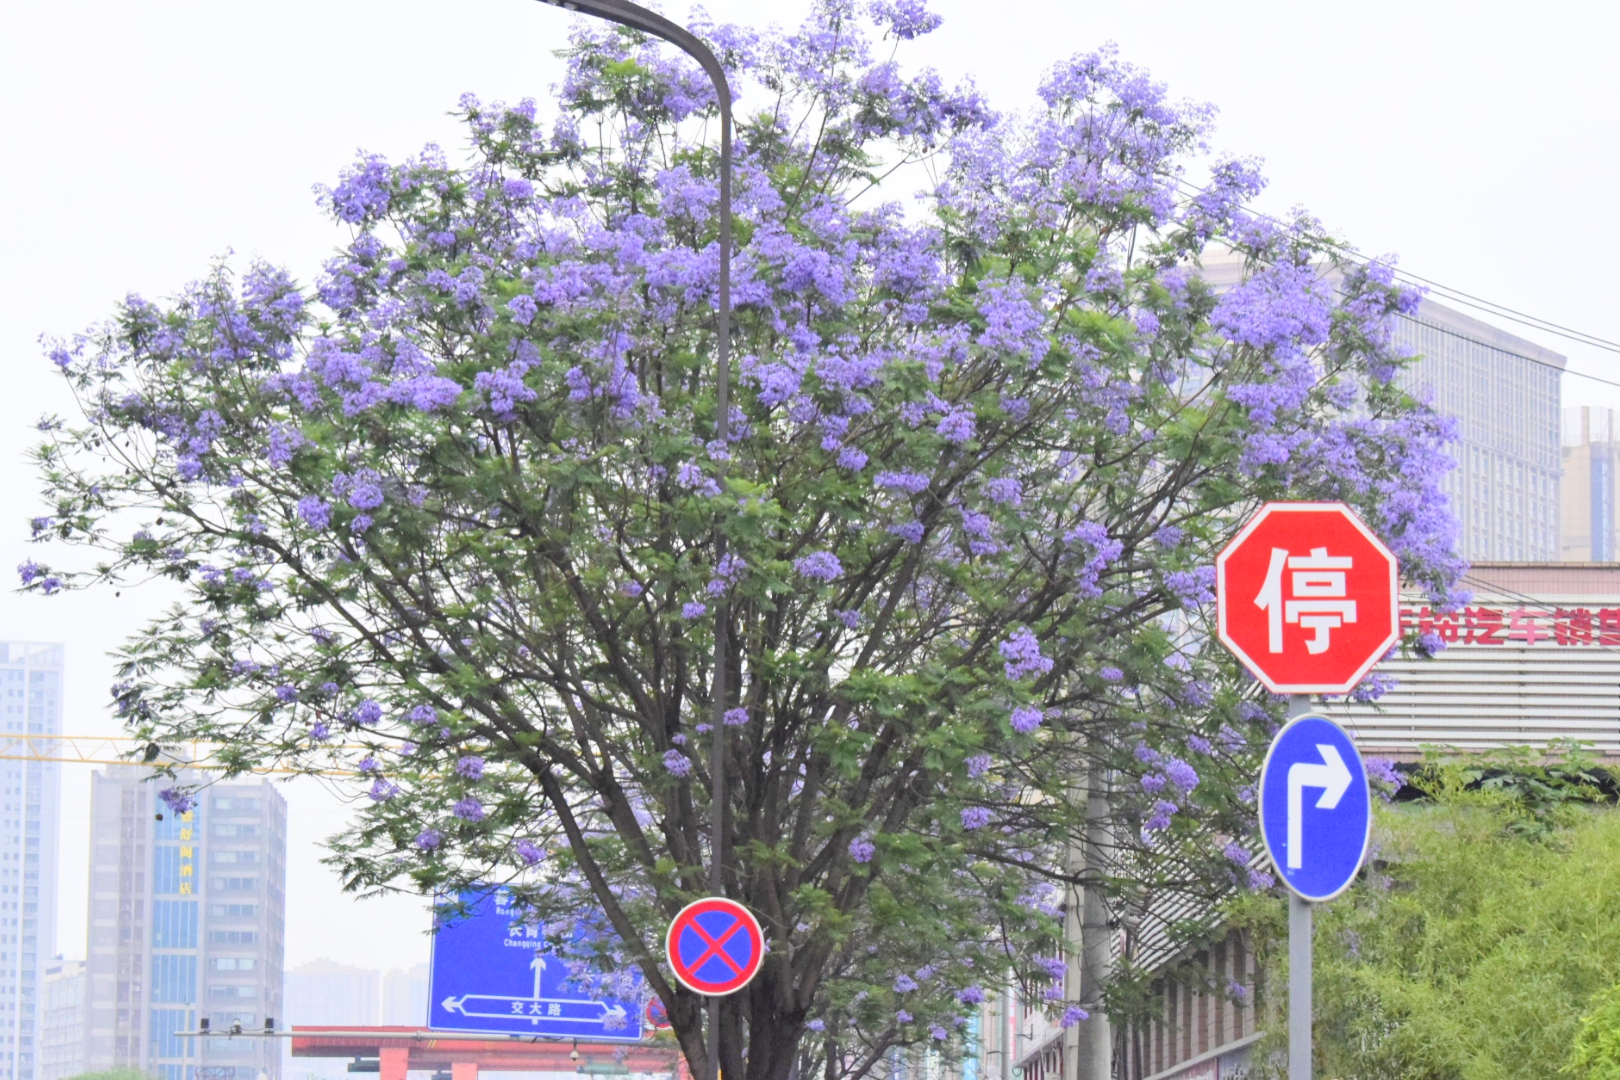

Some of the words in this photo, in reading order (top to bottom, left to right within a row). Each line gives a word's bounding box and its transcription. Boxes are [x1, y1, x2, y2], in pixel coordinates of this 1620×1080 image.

[1254, 547, 1357, 655] 停
[1400, 606, 1620, 646] 铃汽车销售
[504, 938, 541, 950] Changqing
[511, 1001, 561, 1017] 交大路
